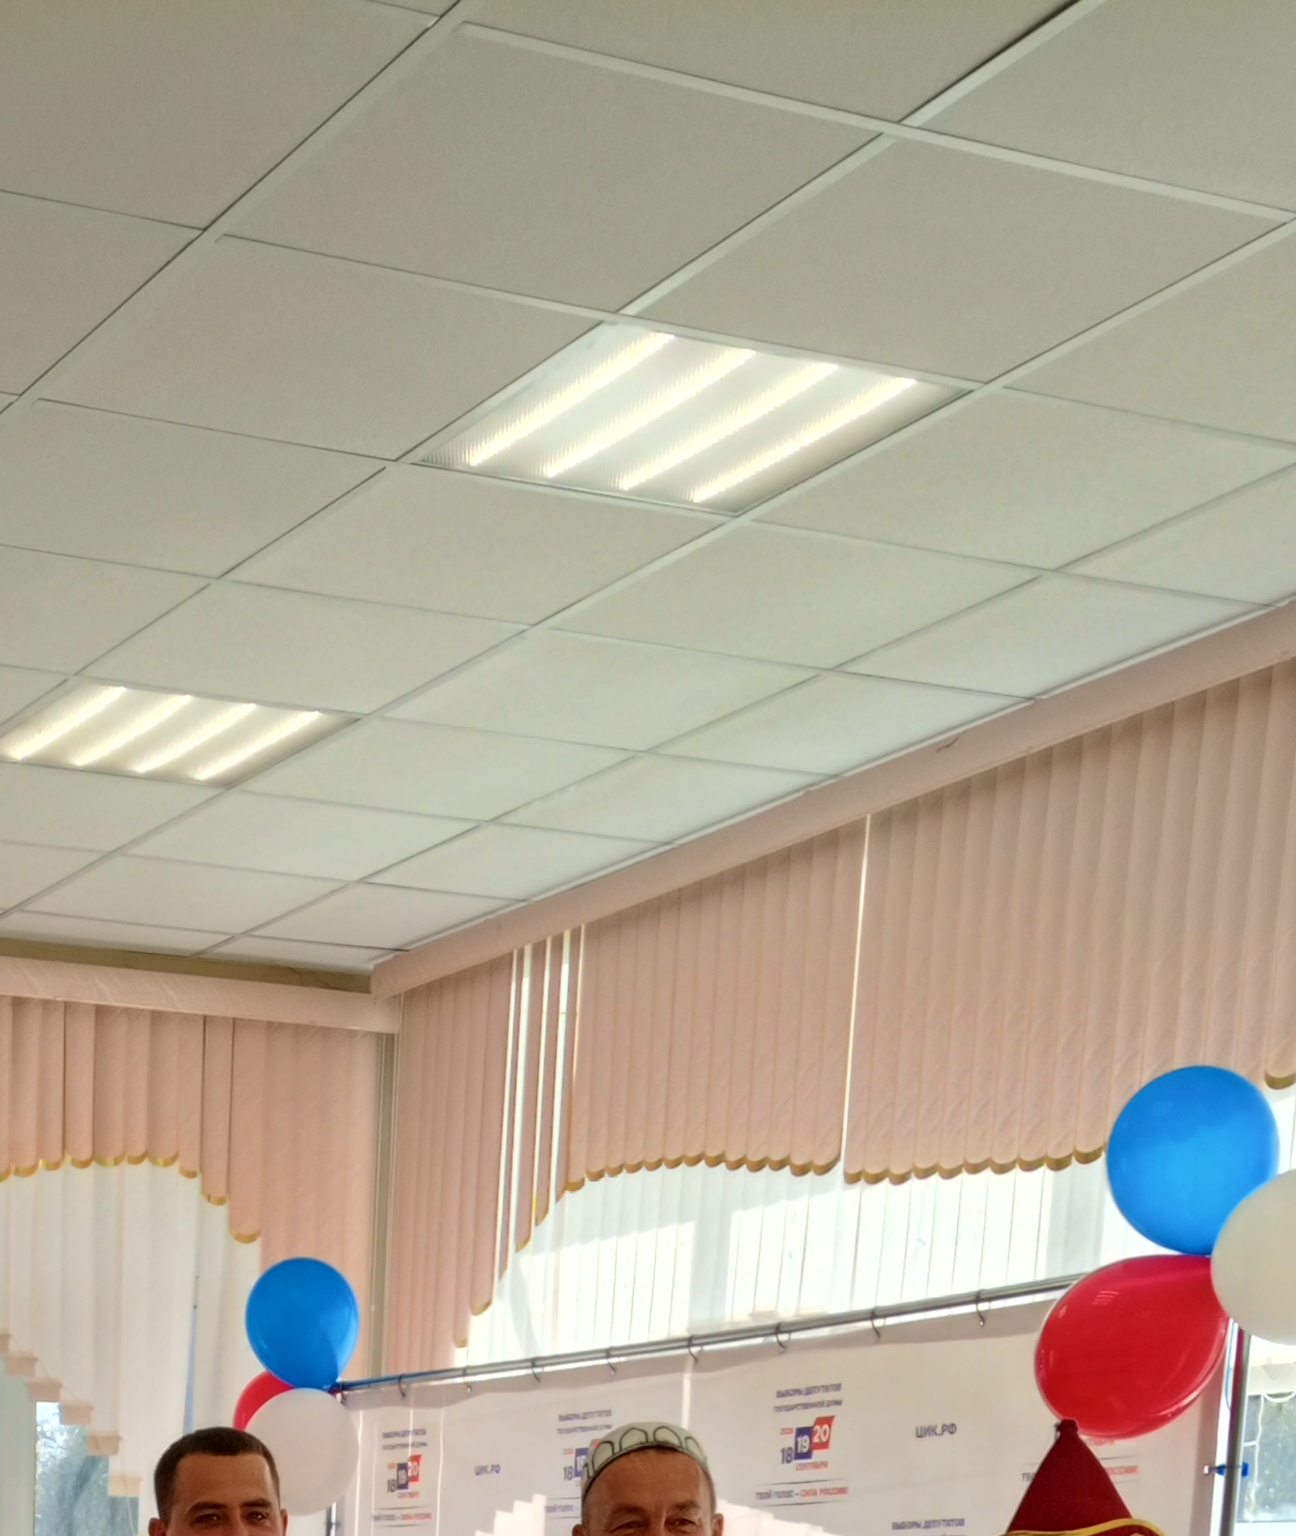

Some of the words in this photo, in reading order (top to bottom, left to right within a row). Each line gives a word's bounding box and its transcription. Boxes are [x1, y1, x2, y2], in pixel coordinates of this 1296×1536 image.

[813, 1424, 830, 1442] 20
[915, 1422, 957, 1438] ЦИК.РФ
[797, 1435, 810, 1453] 19
[781, 1447, 793, 1464] 18
